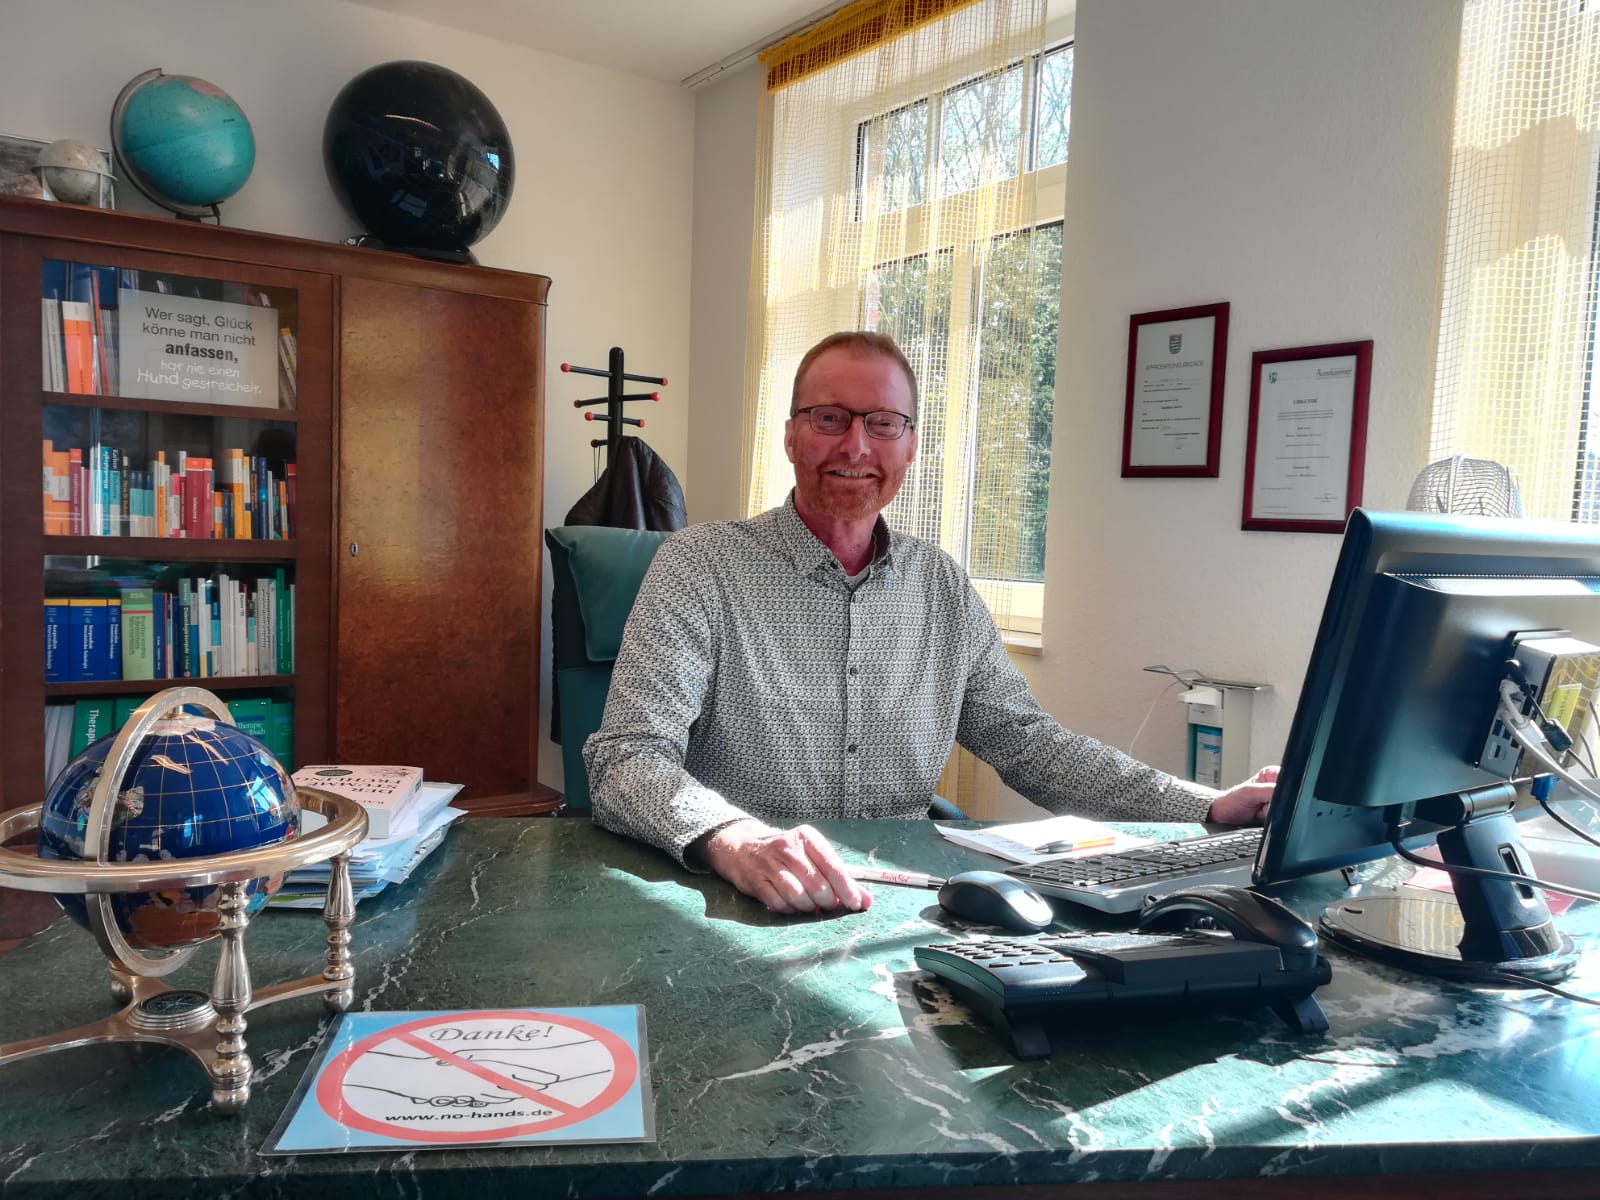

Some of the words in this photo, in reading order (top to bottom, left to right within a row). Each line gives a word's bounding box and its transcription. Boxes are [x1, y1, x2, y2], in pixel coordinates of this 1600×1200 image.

[144, 306, 173, 321] Wer
[176, 311, 210, 328] sagt,
[214, 315, 253, 331] Glück
[142, 322, 186, 338] könne
[190, 329, 220, 342] man
[223, 332, 256, 346] nicht
[165, 342, 239, 363] anfassen,
[160, 359, 184, 373] hat
[187, 362, 205, 375] nie
[208, 365, 240, 378] einen
[137, 368, 179, 386] Hund
[182, 376, 262, 395] gestreichelt.
[429, 1025, 553, 1042] Danke!
[385, 1108, 553, 1122] www.no-hands.de
